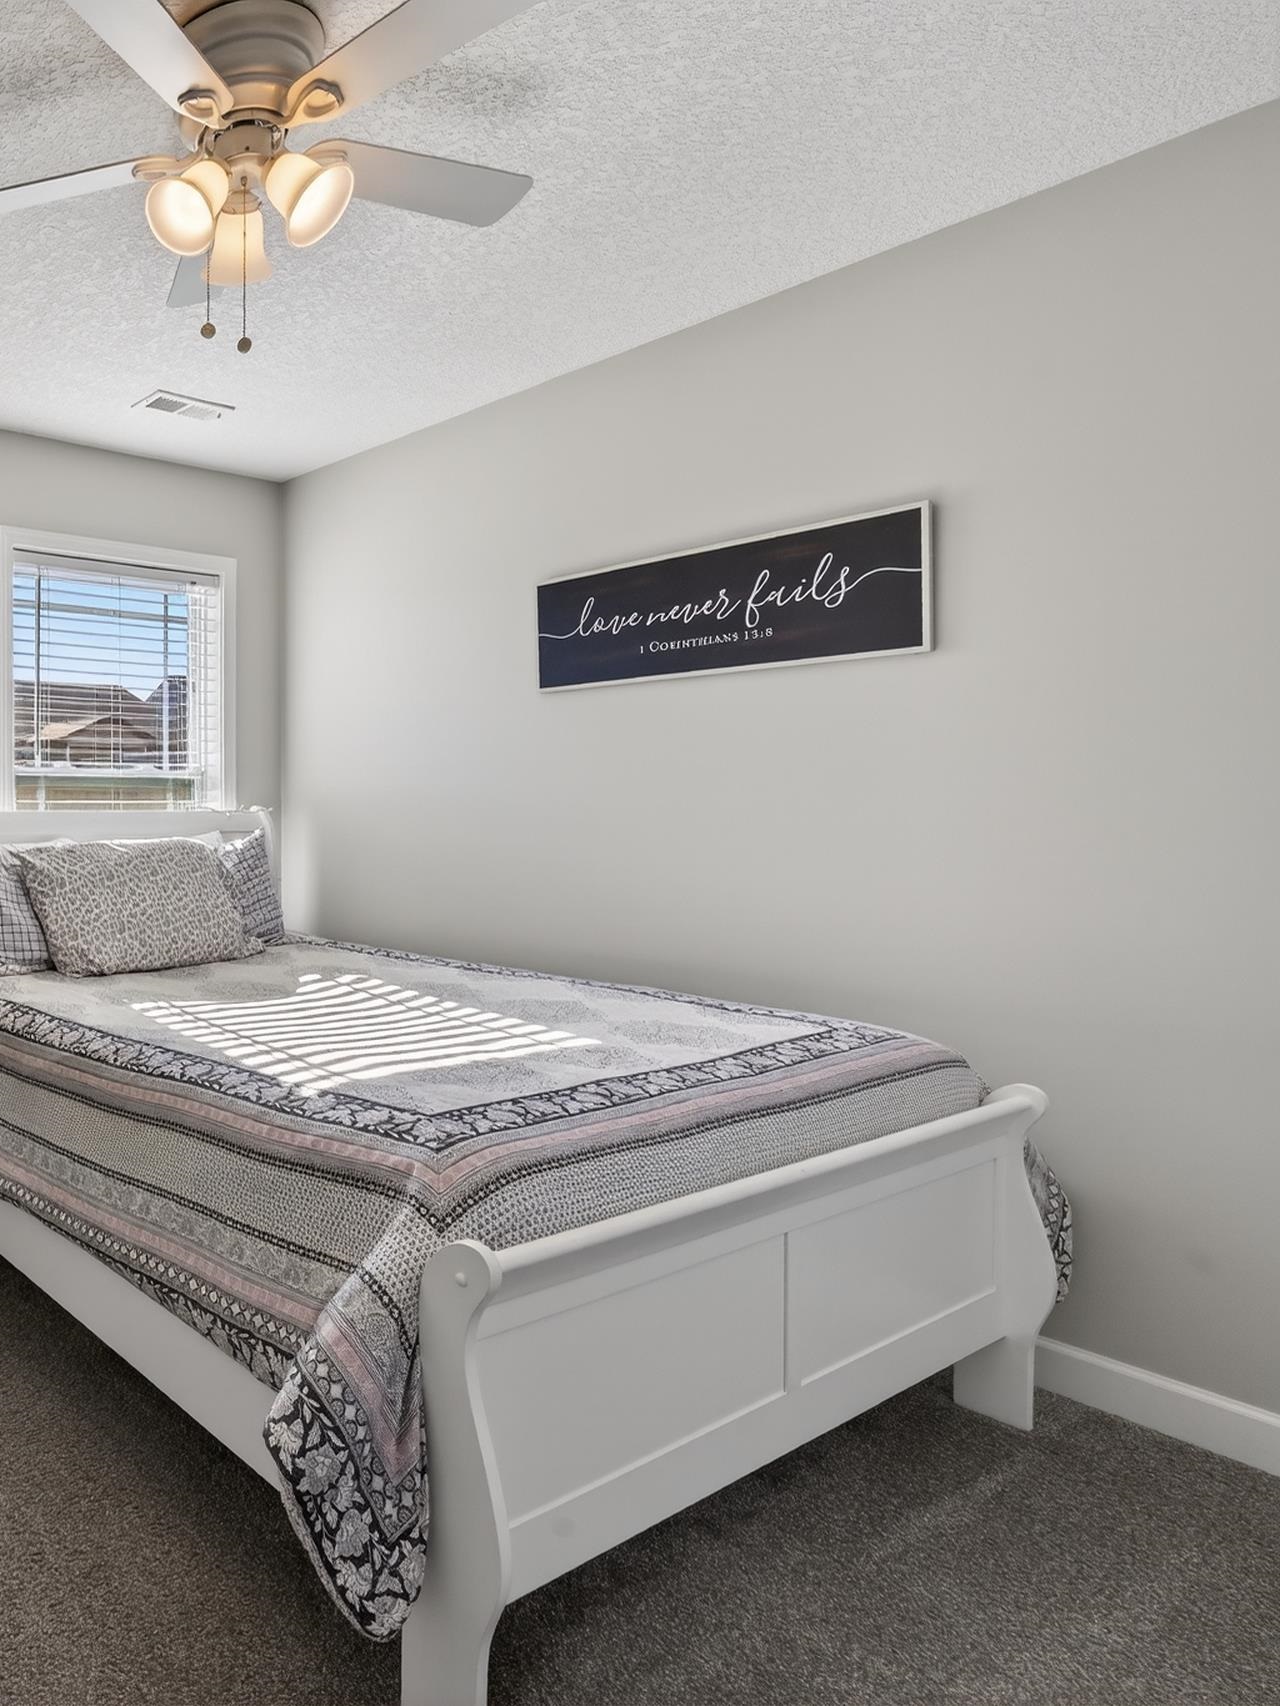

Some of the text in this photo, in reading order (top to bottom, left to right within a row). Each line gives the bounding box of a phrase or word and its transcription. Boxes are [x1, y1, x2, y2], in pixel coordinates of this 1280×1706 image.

[568, 552, 857, 639] love never fails
[744, 627, 774, 641] 13:8
